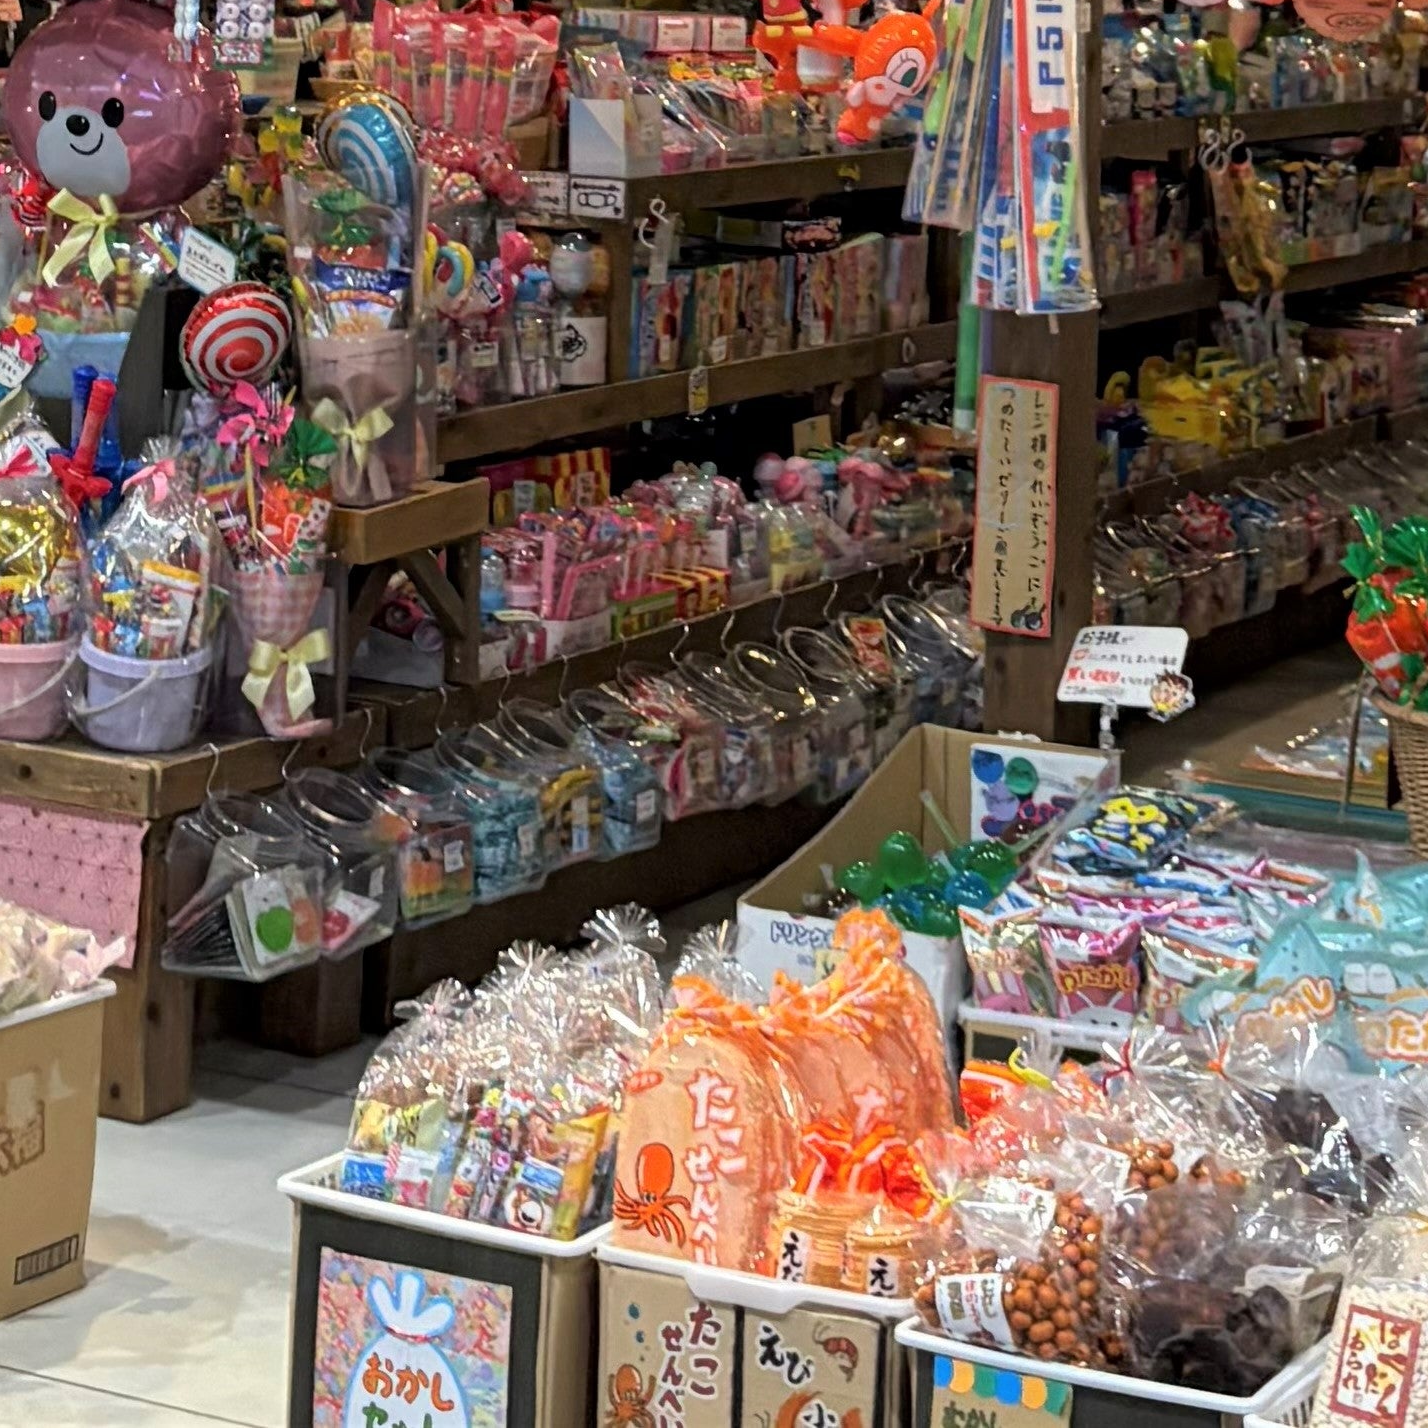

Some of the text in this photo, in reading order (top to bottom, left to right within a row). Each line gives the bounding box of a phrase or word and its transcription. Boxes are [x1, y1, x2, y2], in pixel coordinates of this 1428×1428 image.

[688, 1302, 721, 1397] たこ
[758, 1324, 812, 1384] えび
[362, 1351, 455, 1412] おかし
